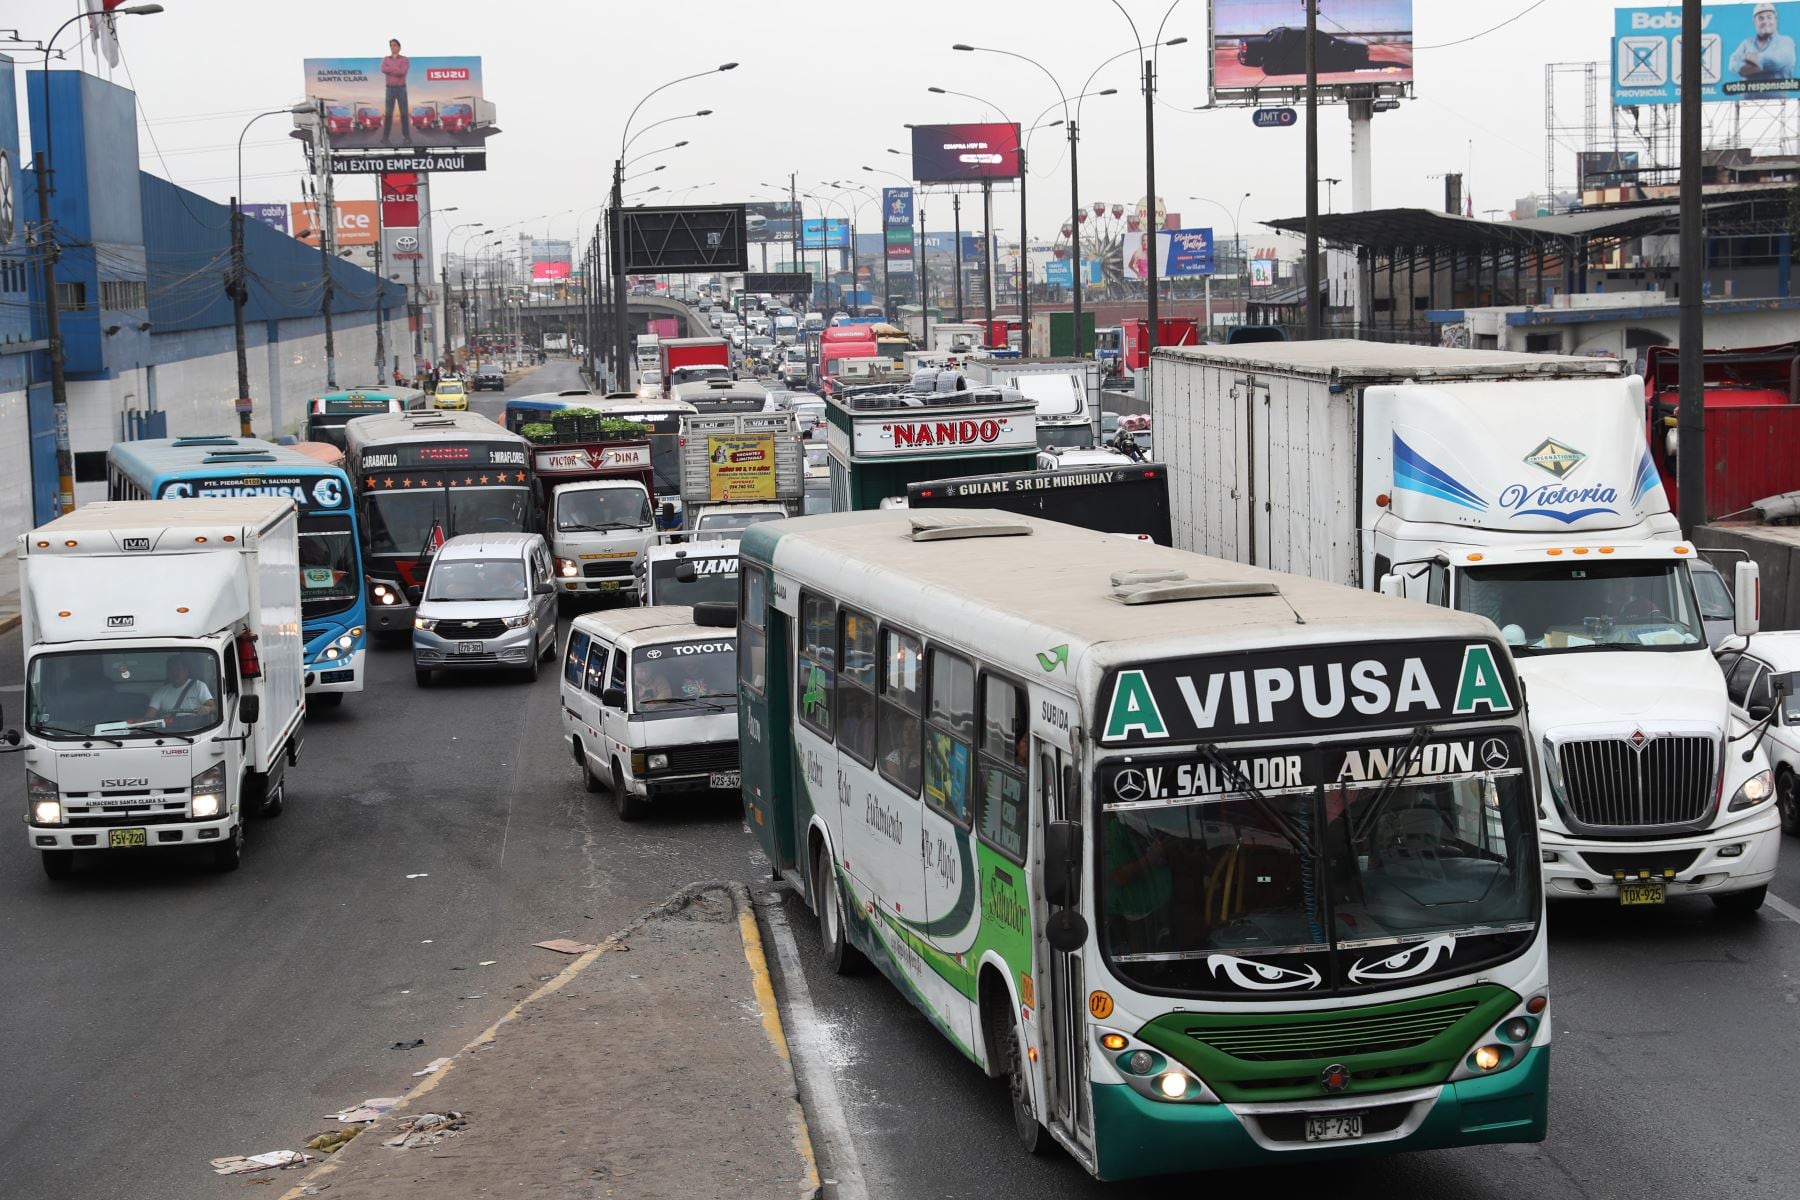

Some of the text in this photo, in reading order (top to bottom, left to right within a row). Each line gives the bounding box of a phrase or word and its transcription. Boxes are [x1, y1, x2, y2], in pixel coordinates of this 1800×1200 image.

[1631, 11, 1713, 30] Boby
[431, 70, 466, 79] ISUZU
[1726, 82, 1745, 92] voto
[1747, 78, 1799, 93] responsable
[1259, 111, 1279, 121] JMT
[333, 160, 347, 172] MI
[387, 156, 434, 170] EMPEZÓ
[437, 155, 465, 169] AQUÍ
[888, 190, 909, 198] Plaza
[262, 206, 285, 219] cabify
[888, 215, 910, 223] Norte
[362, 454, 398, 468] CARABAYLLO
[549, 454, 577, 467] VICTOR
[615, 452, 639, 463] DINA
[960, 471, 1114, 496] GUIAME SR DE MURUHUAY
[1499, 483, 1617, 509] Victoria
[673, 642, 734, 656] TOYOTA
[1102, 644, 1514, 741] A VIPUSA A
[1041, 700, 1069, 732] SUBIDA
[101, 778, 148, 787] ISUZU
[711, 776, 740, 787] W2S-347
[1146, 767, 1168, 798] V.
[111, 832, 145, 845] F5Y-720
[1308, 1116, 1360, 1137] A3F-730
